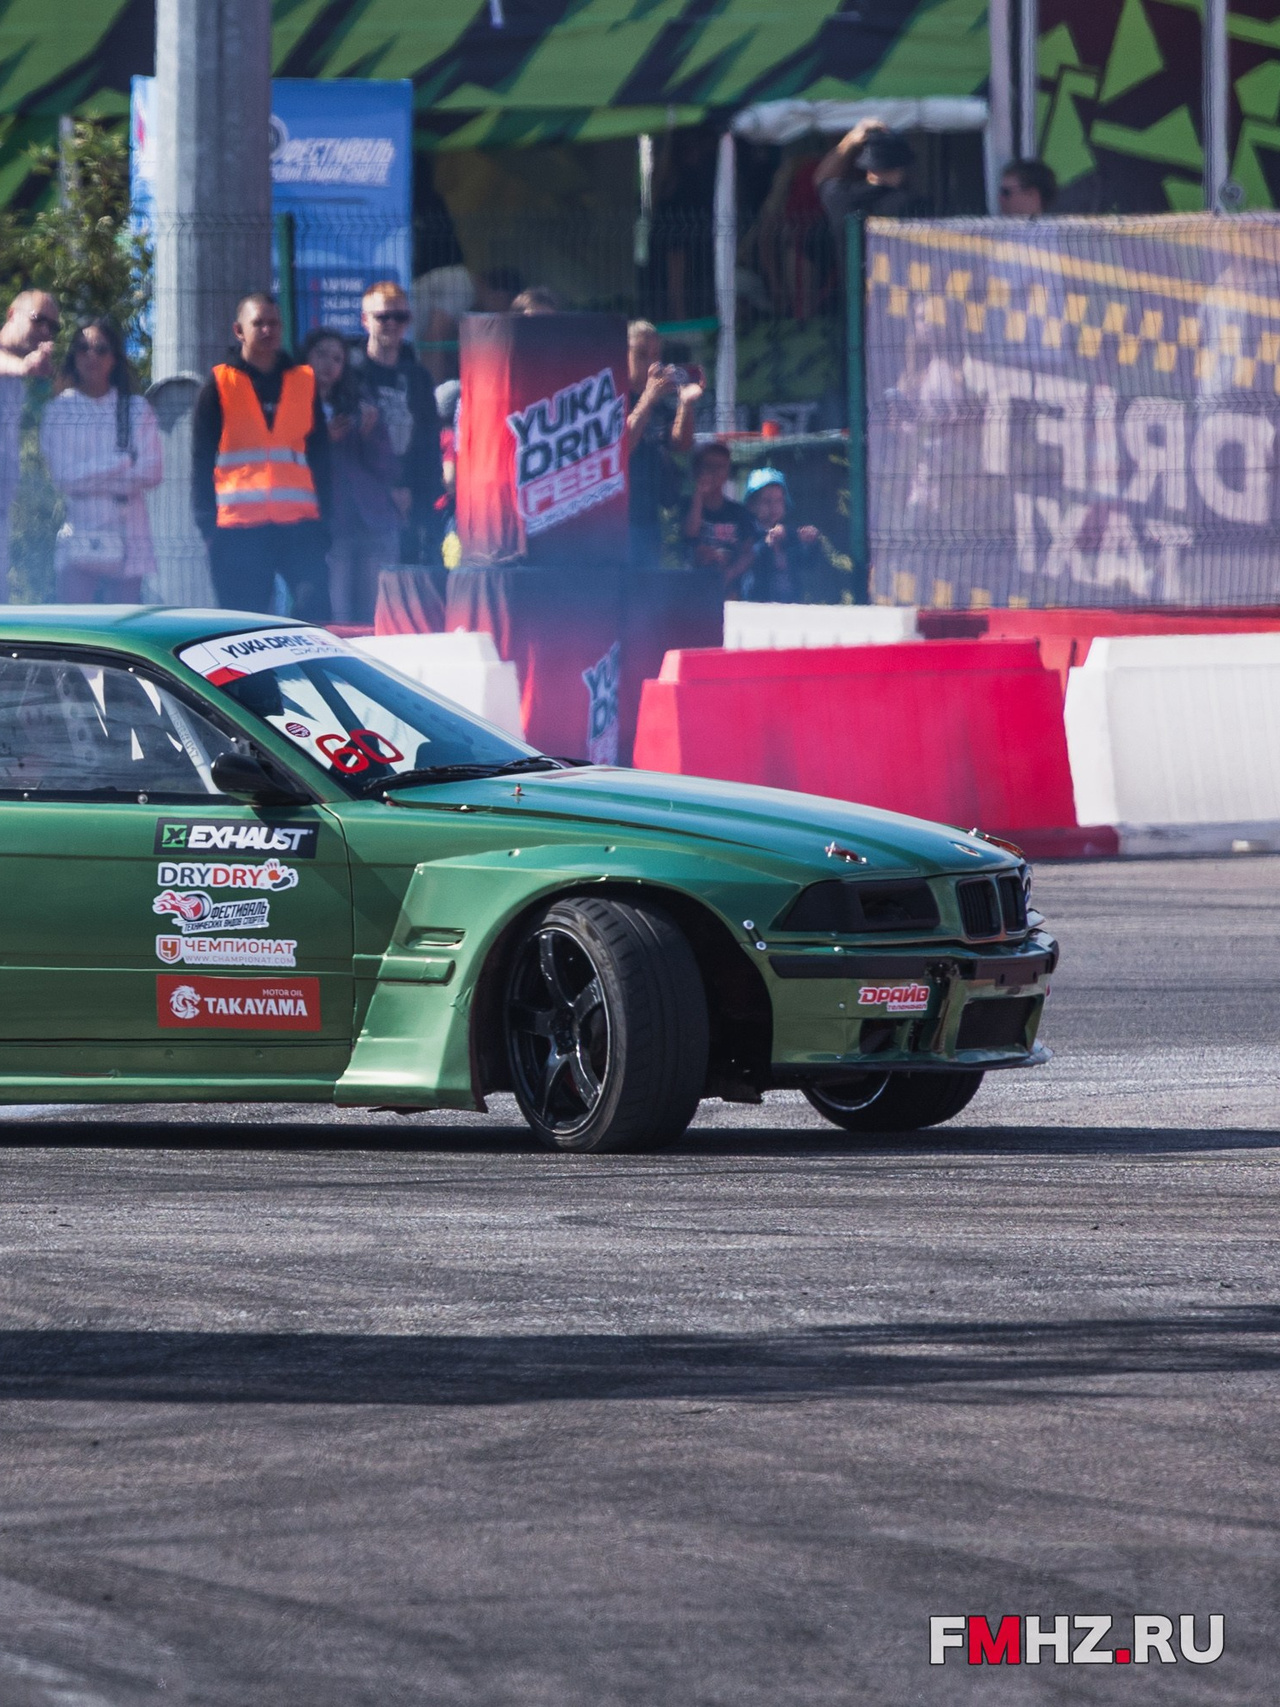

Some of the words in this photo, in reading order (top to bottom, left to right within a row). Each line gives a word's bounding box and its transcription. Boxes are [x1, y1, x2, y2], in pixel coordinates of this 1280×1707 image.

[509, 373, 615, 446] YUKA
[220, 639, 265, 658] YUKA
[264, 635, 314, 649] DRIVE
[315, 729, 404, 774] 60
[187, 825, 309, 850] EXHAUST
[160, 866, 266, 887] DRYDRY
[210, 901, 268, 919] ФЕСТИВАЛЬ
[185, 940, 295, 954] ЧЕМПИОНАТ
[185, 955, 294, 964] WWW.CHAMPIONAT.COM
[262, 989, 289, 997] MOTOR
[290, 989, 304, 997] OIL
[204, 997, 308, 1016] TAKAYAMA
